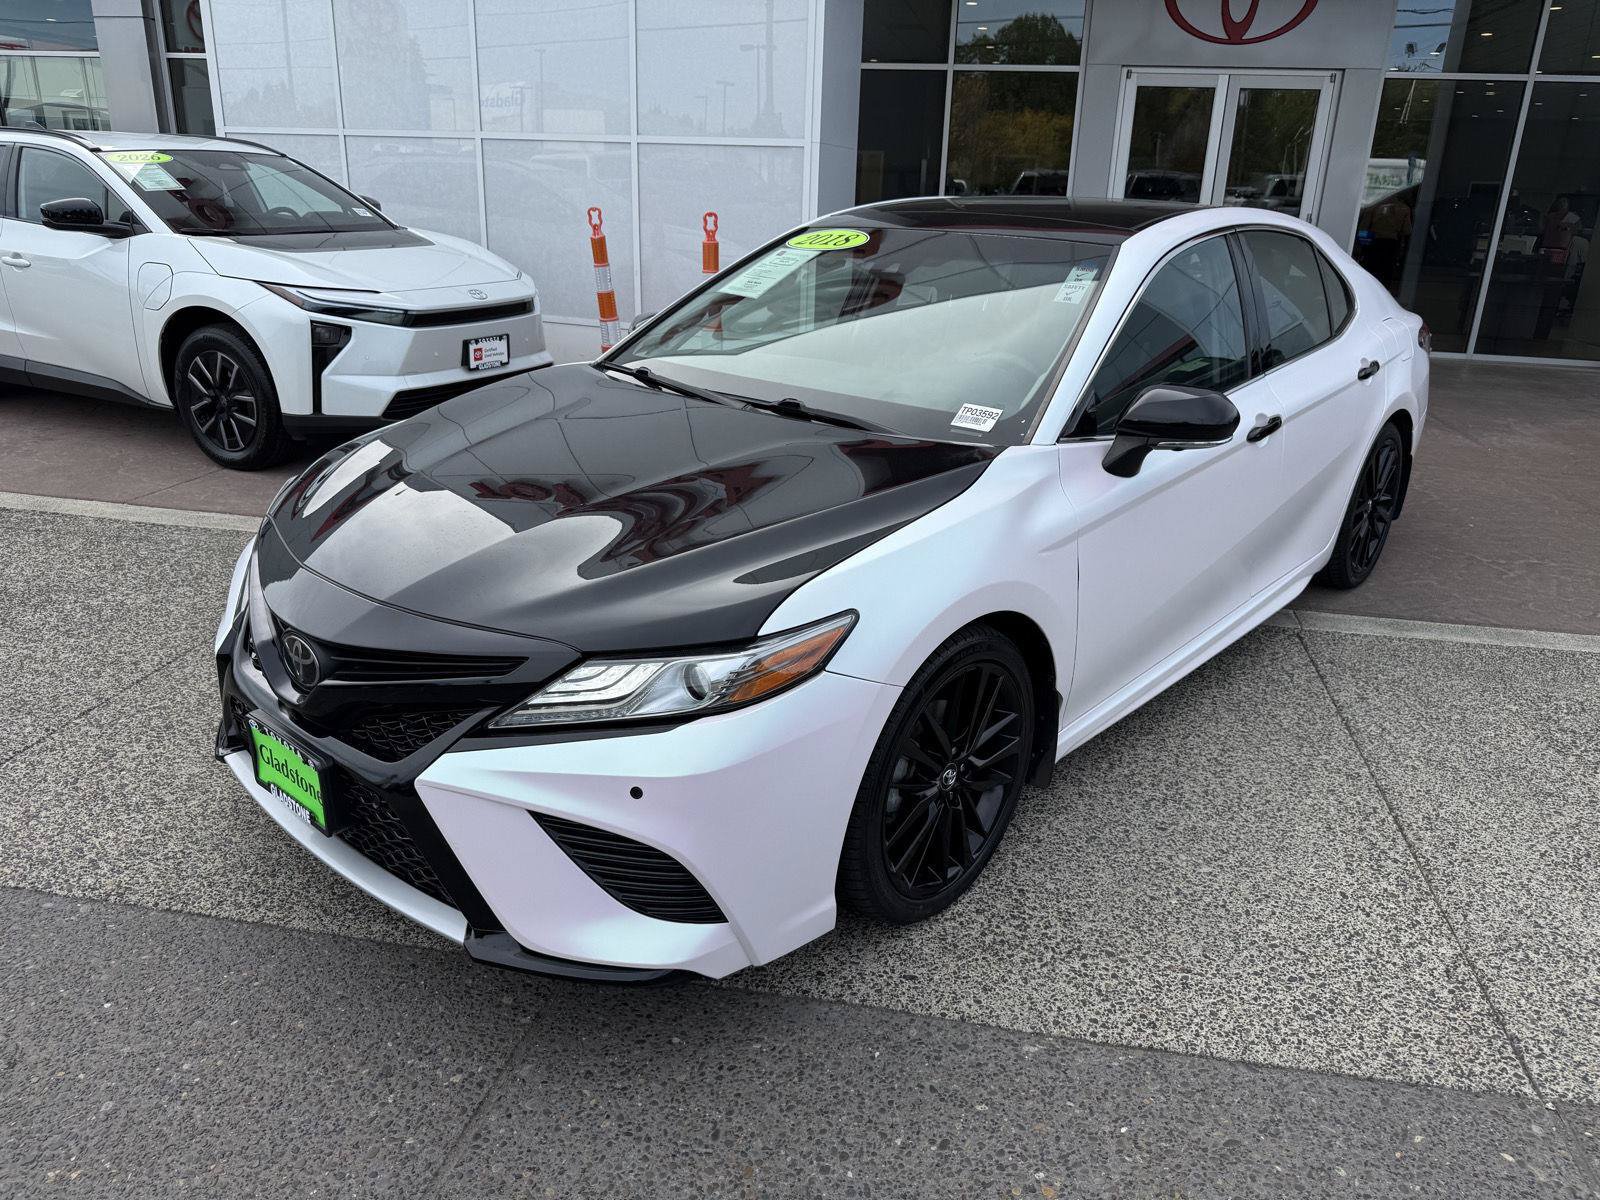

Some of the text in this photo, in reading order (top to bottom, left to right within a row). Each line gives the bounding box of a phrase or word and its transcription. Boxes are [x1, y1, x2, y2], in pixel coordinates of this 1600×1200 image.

[794, 234, 860, 246] 2018
[961, 406, 1000, 420] TP03592
[270, 783, 311, 824] GLADSTONE
